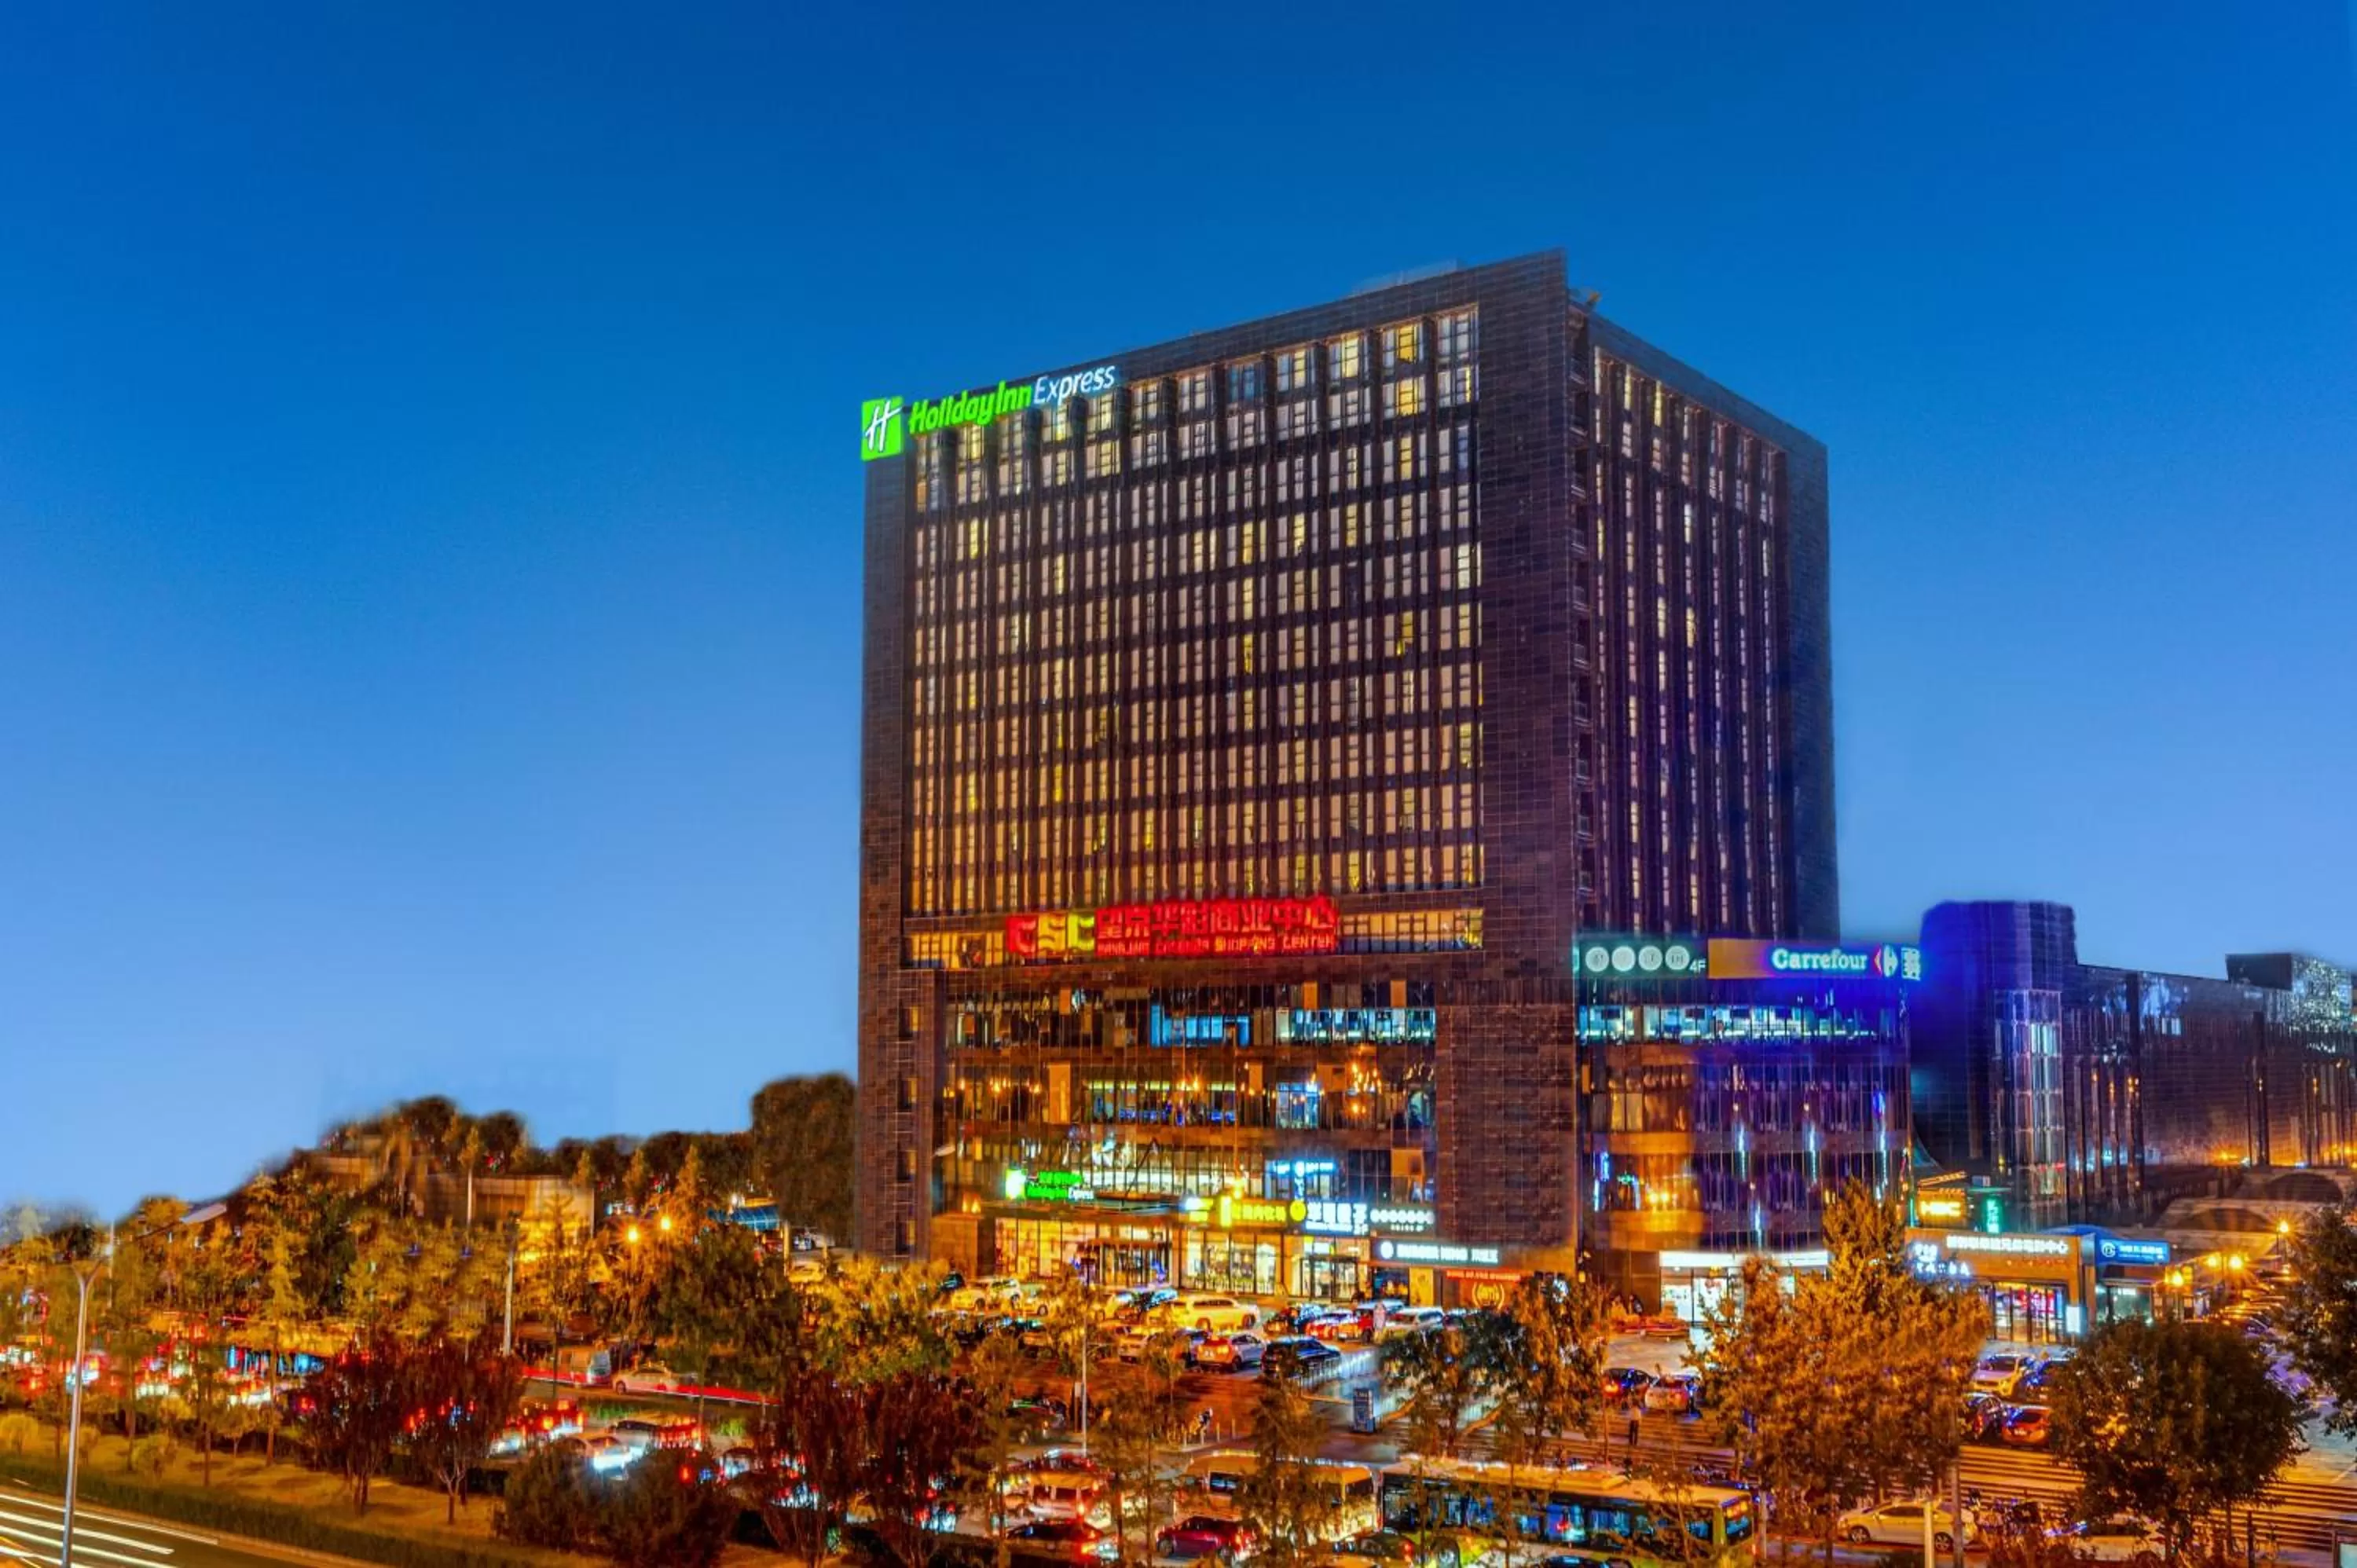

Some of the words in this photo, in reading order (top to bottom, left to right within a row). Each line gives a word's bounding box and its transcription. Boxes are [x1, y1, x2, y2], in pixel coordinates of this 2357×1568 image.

[1033, 365, 1116, 409] Express
[1283, 932, 1335, 950] CENTER
[1689, 958, 1706, 975] 4F
[1771, 947, 1868, 970] Carrefour
